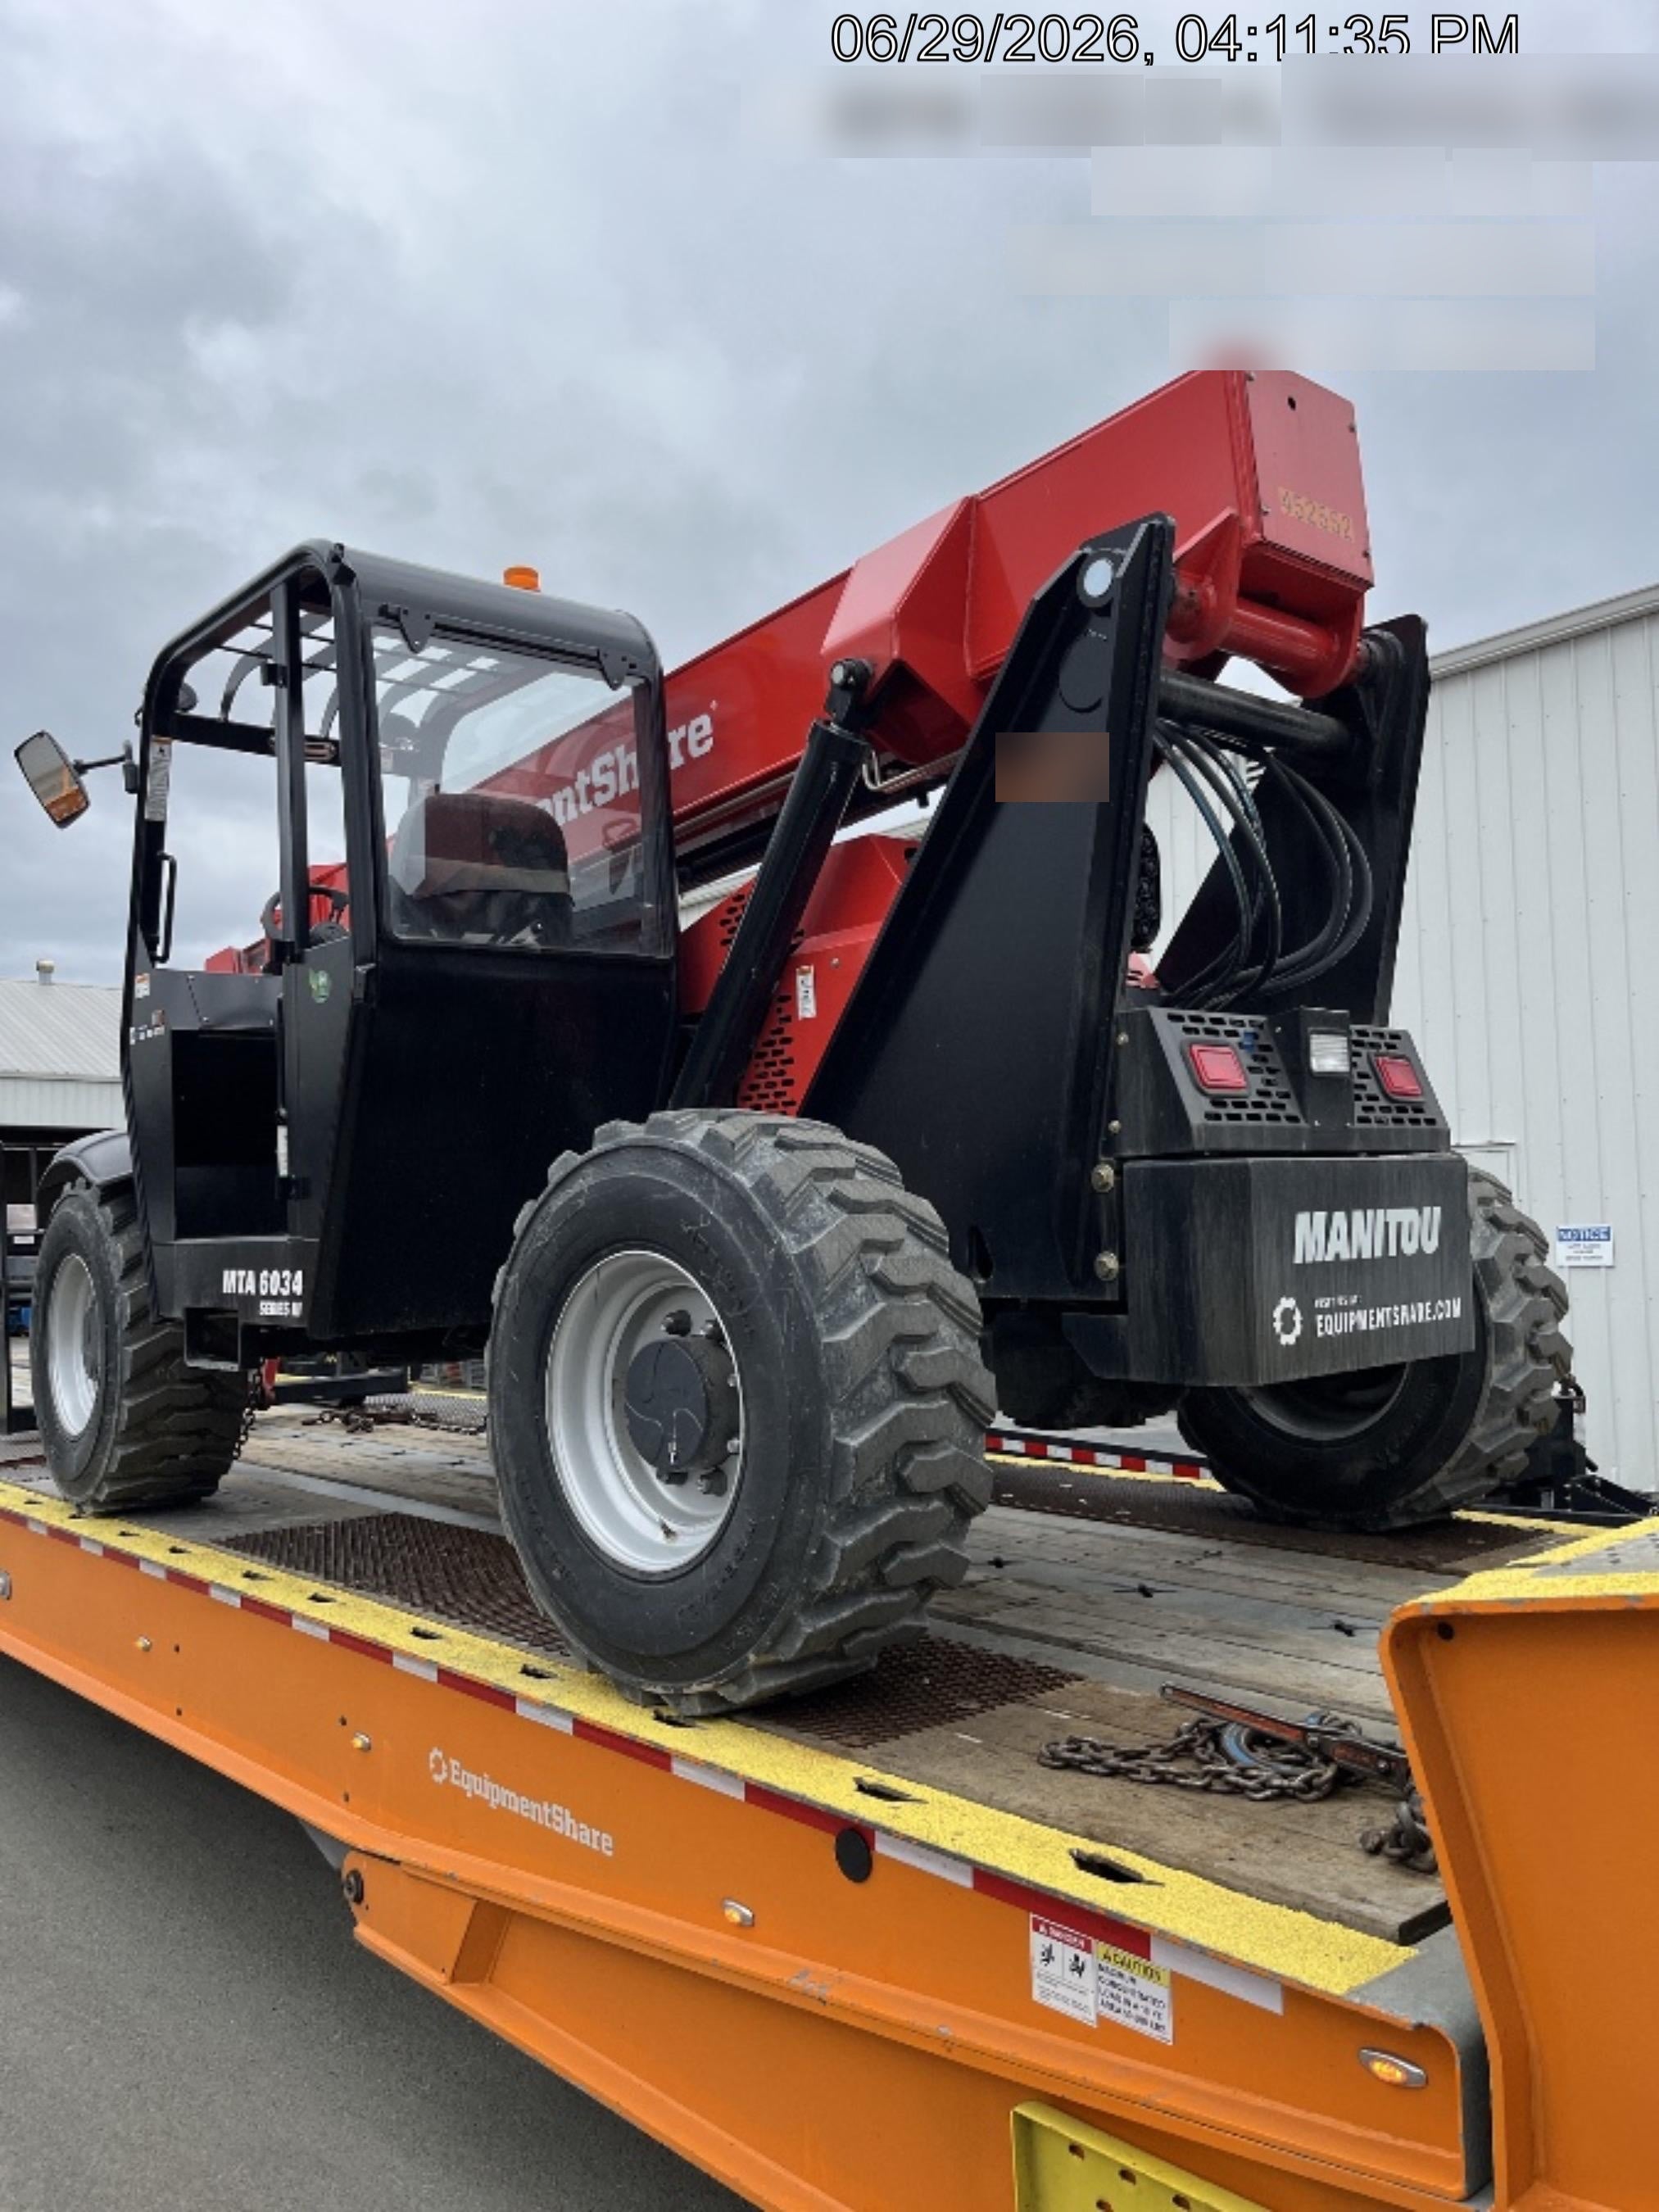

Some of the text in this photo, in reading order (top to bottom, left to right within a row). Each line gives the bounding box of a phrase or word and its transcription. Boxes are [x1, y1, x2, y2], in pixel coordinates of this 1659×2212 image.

[1294, 1206, 1441, 1264] MANITOU
[1559, 1227, 1608, 1240] NOTICE
[222, 1269, 303, 1296] MTA 6034
[1316, 1297, 1462, 1338] EQUIPMENTSHARE.COM
[449, 1756, 614, 1858] EquipmentShare
[1113, 1950, 1162, 1983] CAUTION
